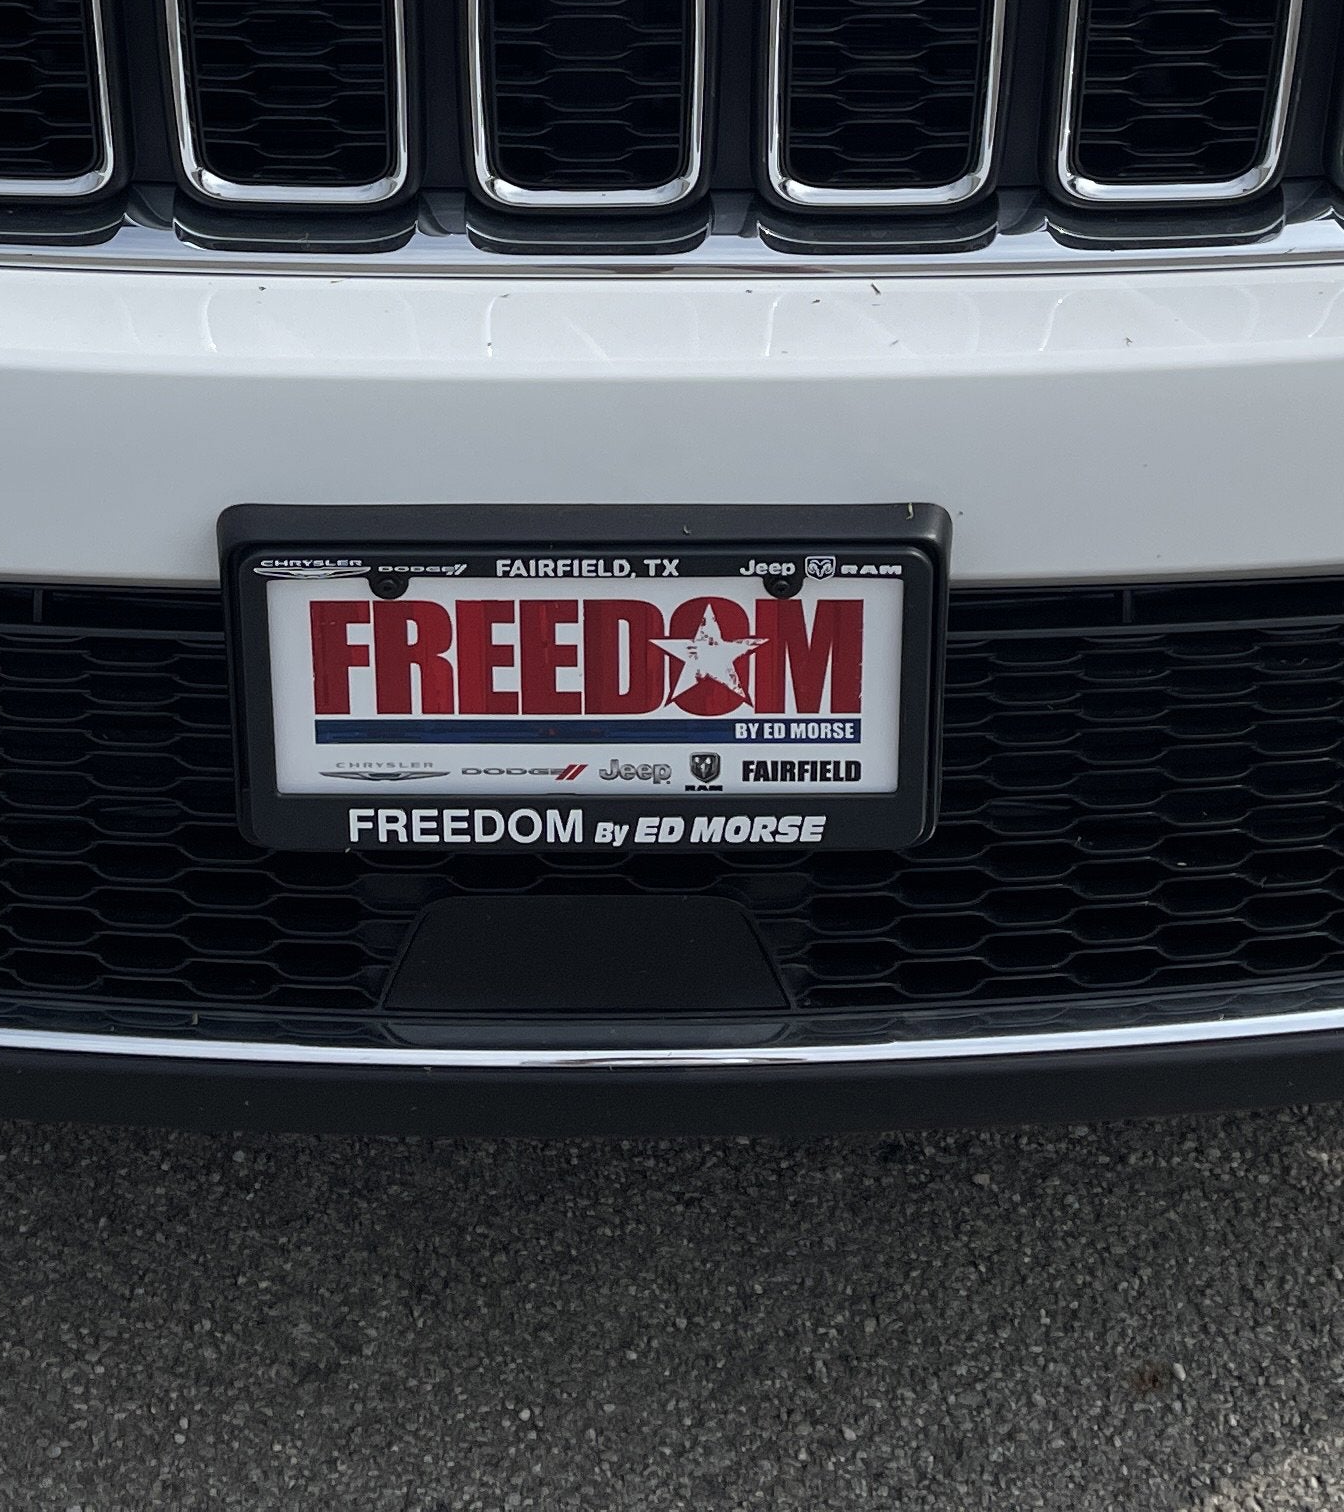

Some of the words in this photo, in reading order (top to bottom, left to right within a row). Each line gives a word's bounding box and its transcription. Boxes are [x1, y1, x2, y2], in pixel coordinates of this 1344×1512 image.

[260, 559, 363, 567] CHRYSLER
[496, 558, 637, 579] FAIRFIELD,
[643, 558, 680, 577] TX
[739, 559, 796, 577] Jeep
[841, 564, 903, 575] RAM
[309, 596, 865, 717] FREEDOM
[735, 722, 760, 739] BY
[763, 722, 786, 739] ED
[790, 722, 855, 739] MORSE
[335, 761, 435, 769] CHRYSLER
[598, 758, 673, 785] Jeep
[742, 759, 862, 783] FAIRFIELD
[684, 784, 724, 792] RAM
[348, 808, 584, 844] FREEDOM
[594, 821, 630, 848] By
[634, 816, 686, 844] ED
[689, 815, 827, 844] MORSE
